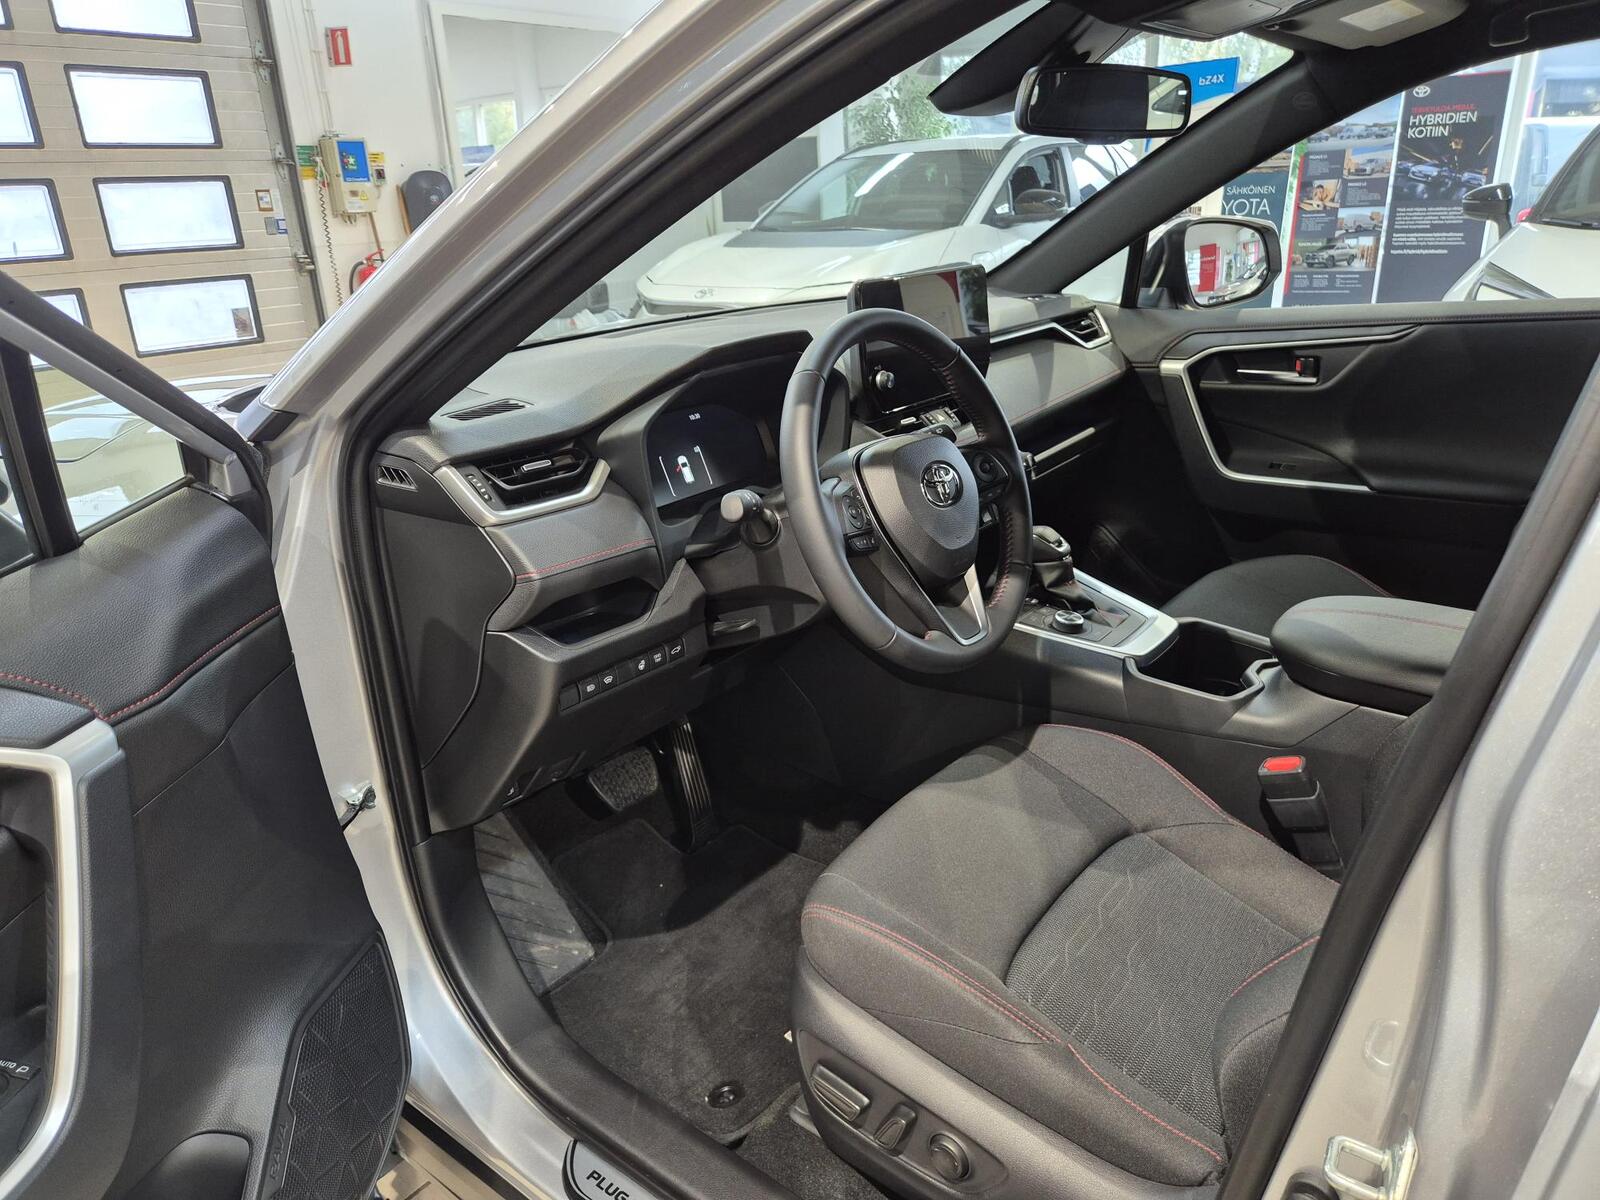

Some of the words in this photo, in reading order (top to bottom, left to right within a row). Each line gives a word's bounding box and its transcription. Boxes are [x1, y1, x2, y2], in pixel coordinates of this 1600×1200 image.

[1199, 74, 1225, 86] bZ4X
[1409, 110, 1478, 126] HYBRIDIEN
[1407, 125, 1449, 139] KOTIIN
[1226, 184, 1276, 195] SÄHKÖINEN
